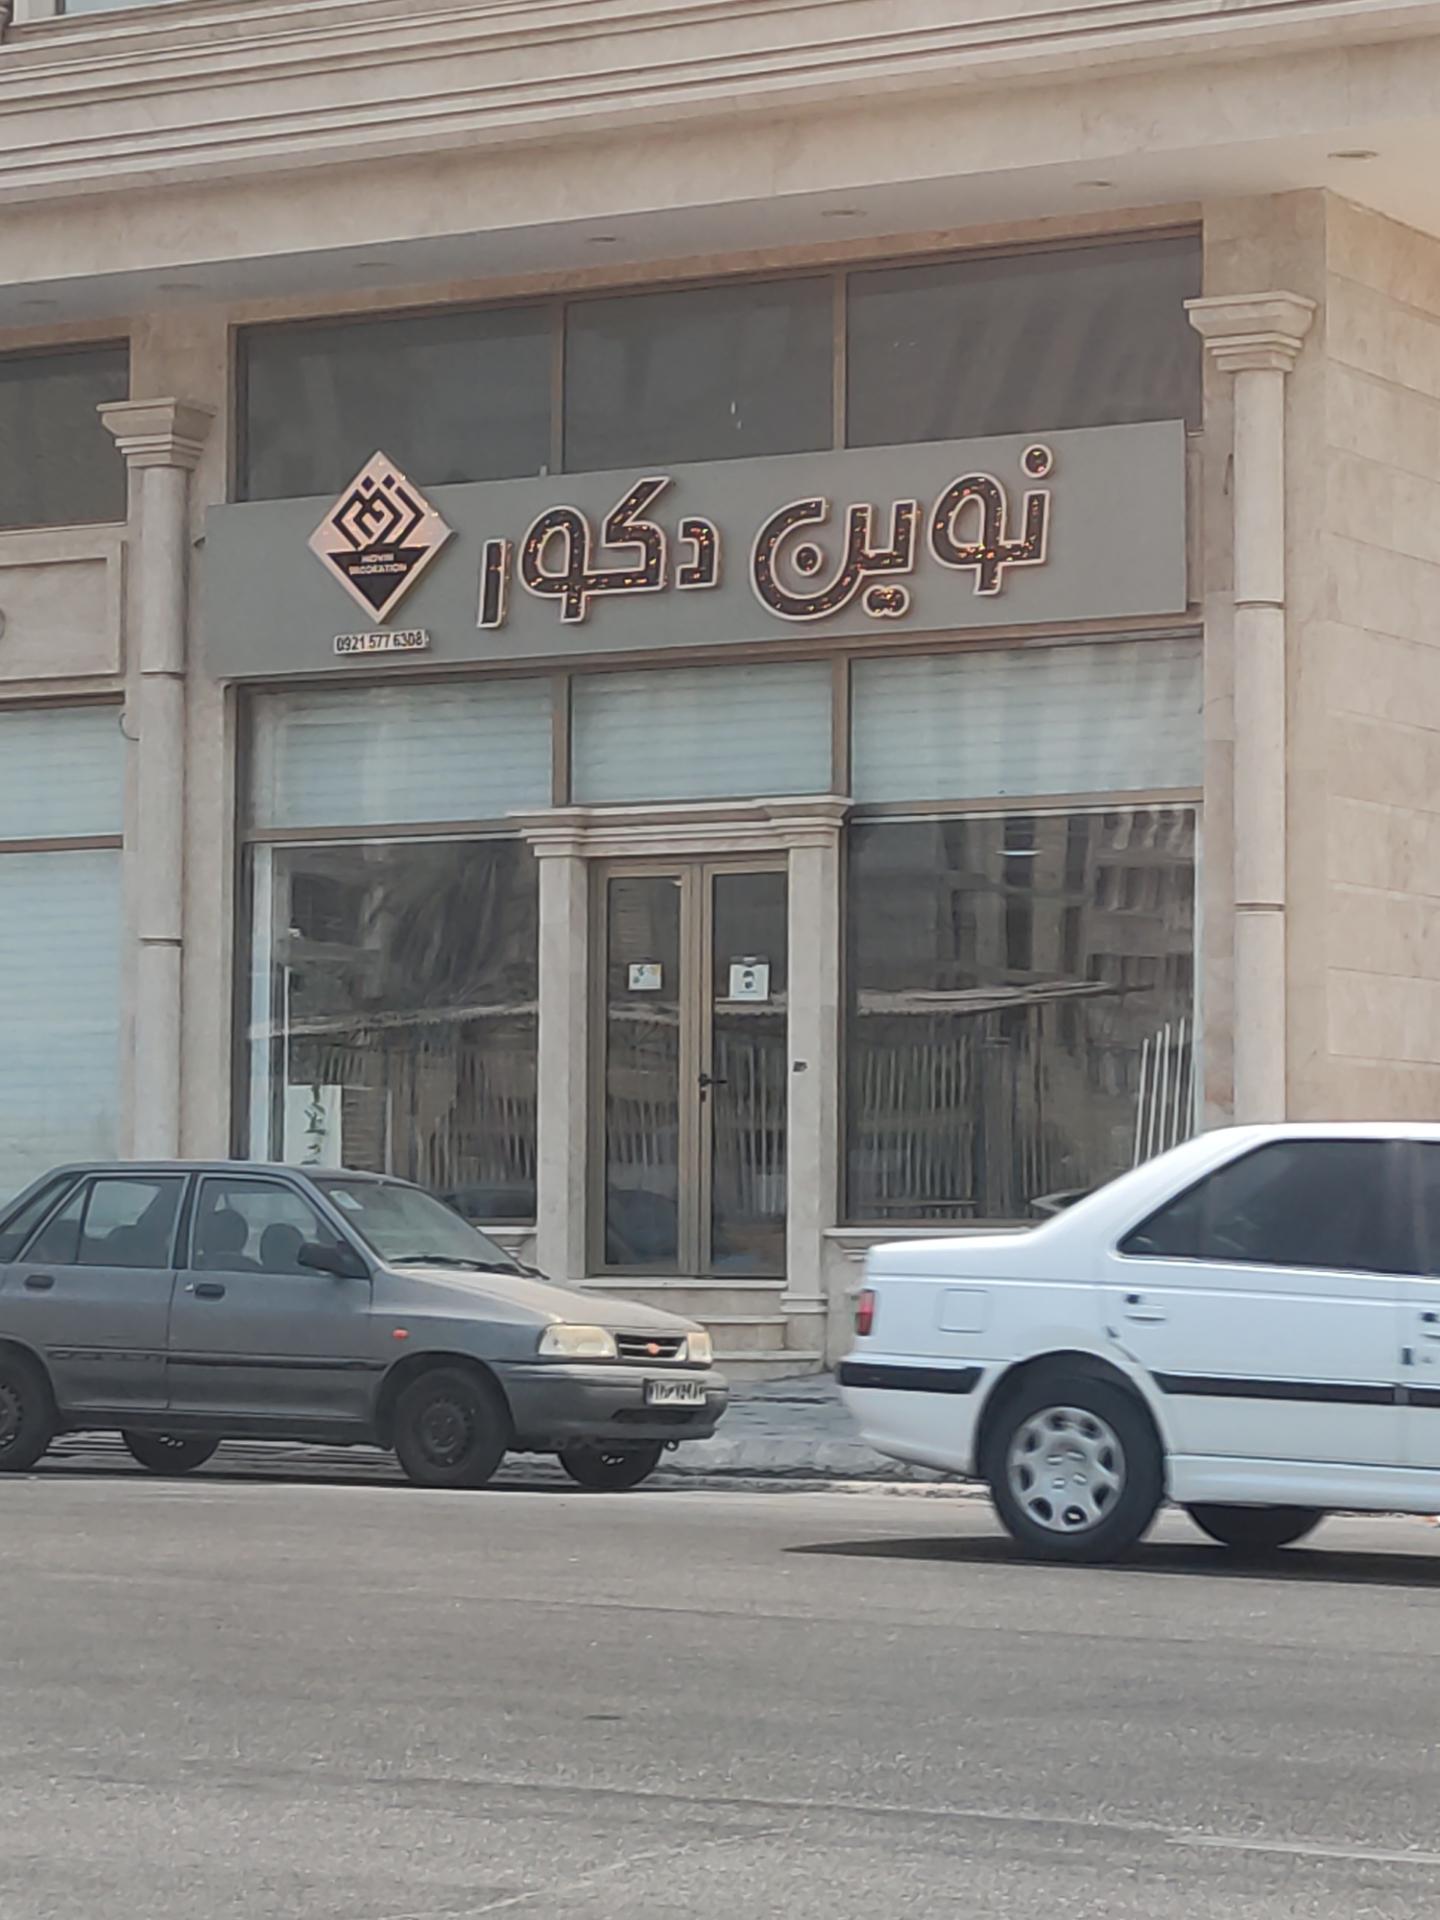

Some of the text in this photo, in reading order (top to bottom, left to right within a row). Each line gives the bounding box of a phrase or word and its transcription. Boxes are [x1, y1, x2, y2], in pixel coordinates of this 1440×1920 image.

[477, 442, 1053, 629] نوین دکور
[336, 631, 423, 652] 0921 577 6308
